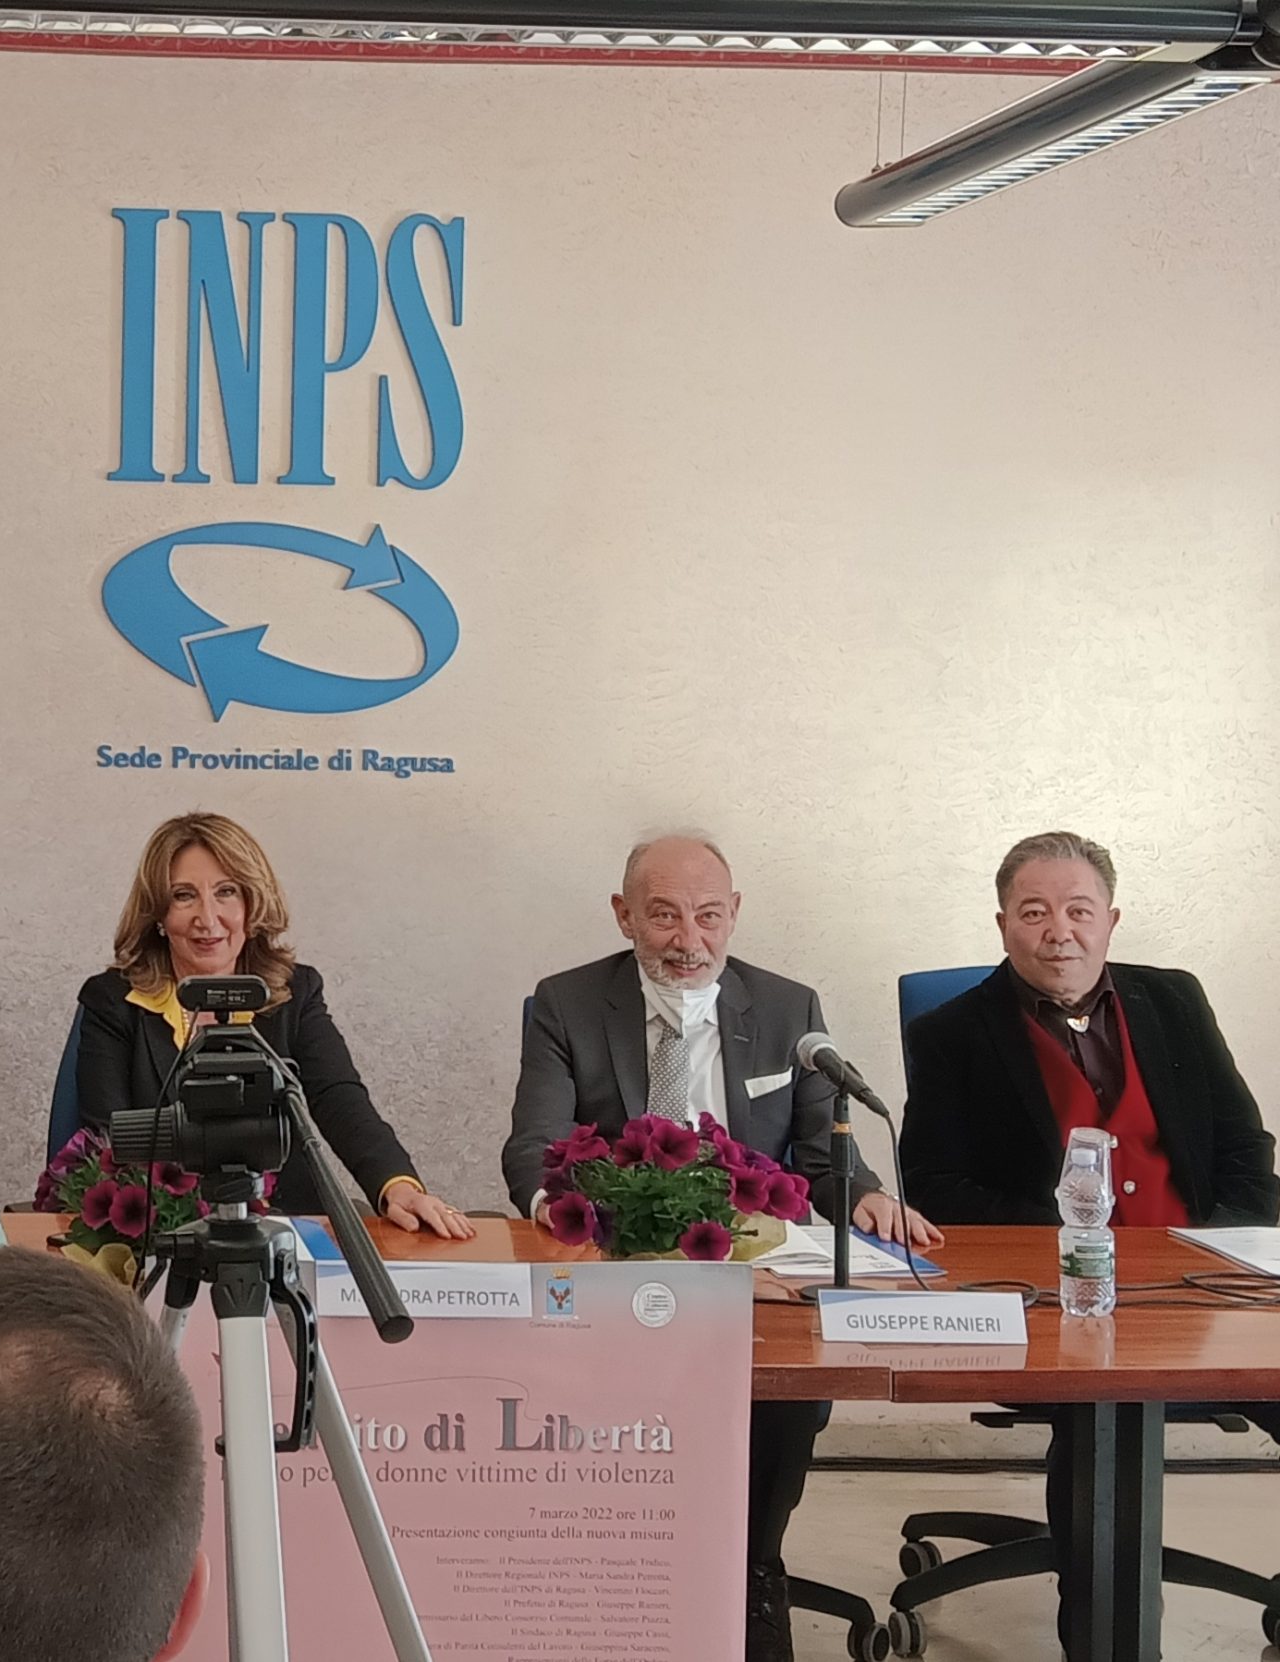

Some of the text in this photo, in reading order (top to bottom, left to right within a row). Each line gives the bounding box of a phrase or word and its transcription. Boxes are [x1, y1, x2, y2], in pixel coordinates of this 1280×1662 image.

[106, 207, 465, 490] INPS
[96, 745, 455, 779] Sede Provinciale di Ragusa
[437, 1290, 520, 1306] PETROTTA
[846, 1314, 1001, 1332] GIUSEPPE RANIERI
[423, 1413, 466, 1452] di
[495, 1398, 674, 1453] Libertà
[376, 1461, 447, 1483] donne
[457, 1461, 537, 1483] vittime
[545, 1461, 567, 1483] di
[576, 1462, 675, 1485] violenza
[528, 1507, 676, 1521] 7 marzo 2022 ore 11:00
[391, 1526, 675, 1541] Presentazione congiunta della nuova misura
